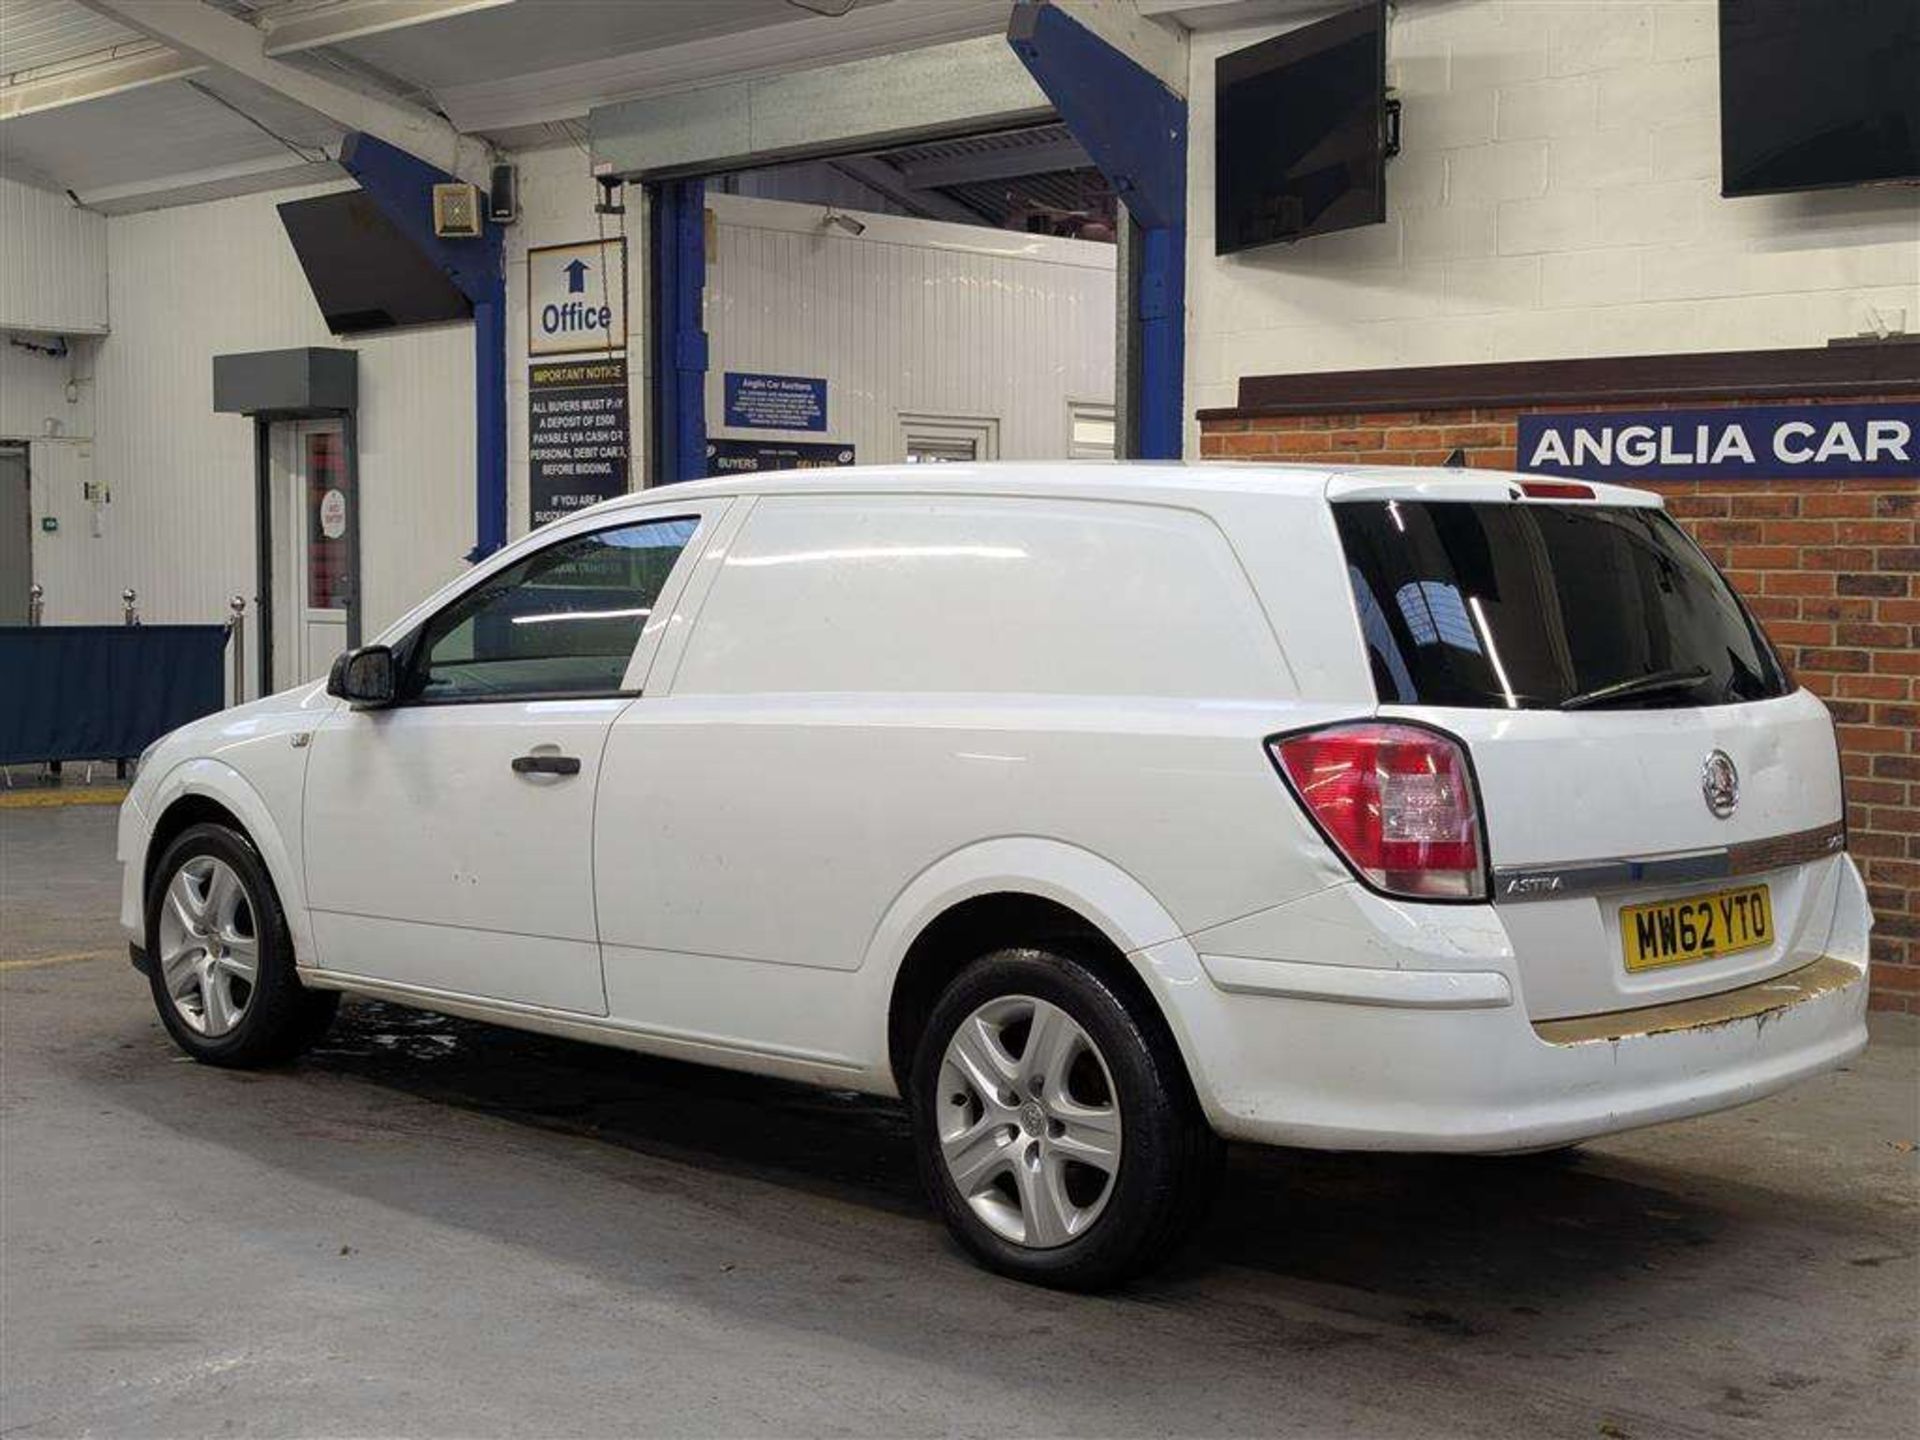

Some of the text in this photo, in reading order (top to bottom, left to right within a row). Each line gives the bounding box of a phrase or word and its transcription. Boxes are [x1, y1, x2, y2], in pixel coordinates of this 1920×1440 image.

[542, 302, 612, 334] Office
[533, 367, 583, 382] IMPORTANT
[532, 402, 547, 413] ALL
[548, 400, 580, 412] BUYERS
[581, 399, 605, 411] MUST
[540, 415, 616, 428] A DEPOSIT OF £500
[533, 433, 568, 444] PAYABLE
[570, 431, 583, 442] VIA
[585, 430, 609, 442] CASH
[1530, 420, 1912, 467] ANGLIA CAR
[530, 448, 572, 460] PERSONAL
[573, 447, 599, 458] DEBIT
[542, 463, 574, 475] BEFORE
[718, 457, 758, 470] BUYERS
[551, 495, 559, 506] IF
[560, 495, 578, 506] YOU
[580, 494, 597, 506] ARE
[1507, 877, 1562, 894] ASTRA
[1636, 892, 1765, 960] MW62 YTO
